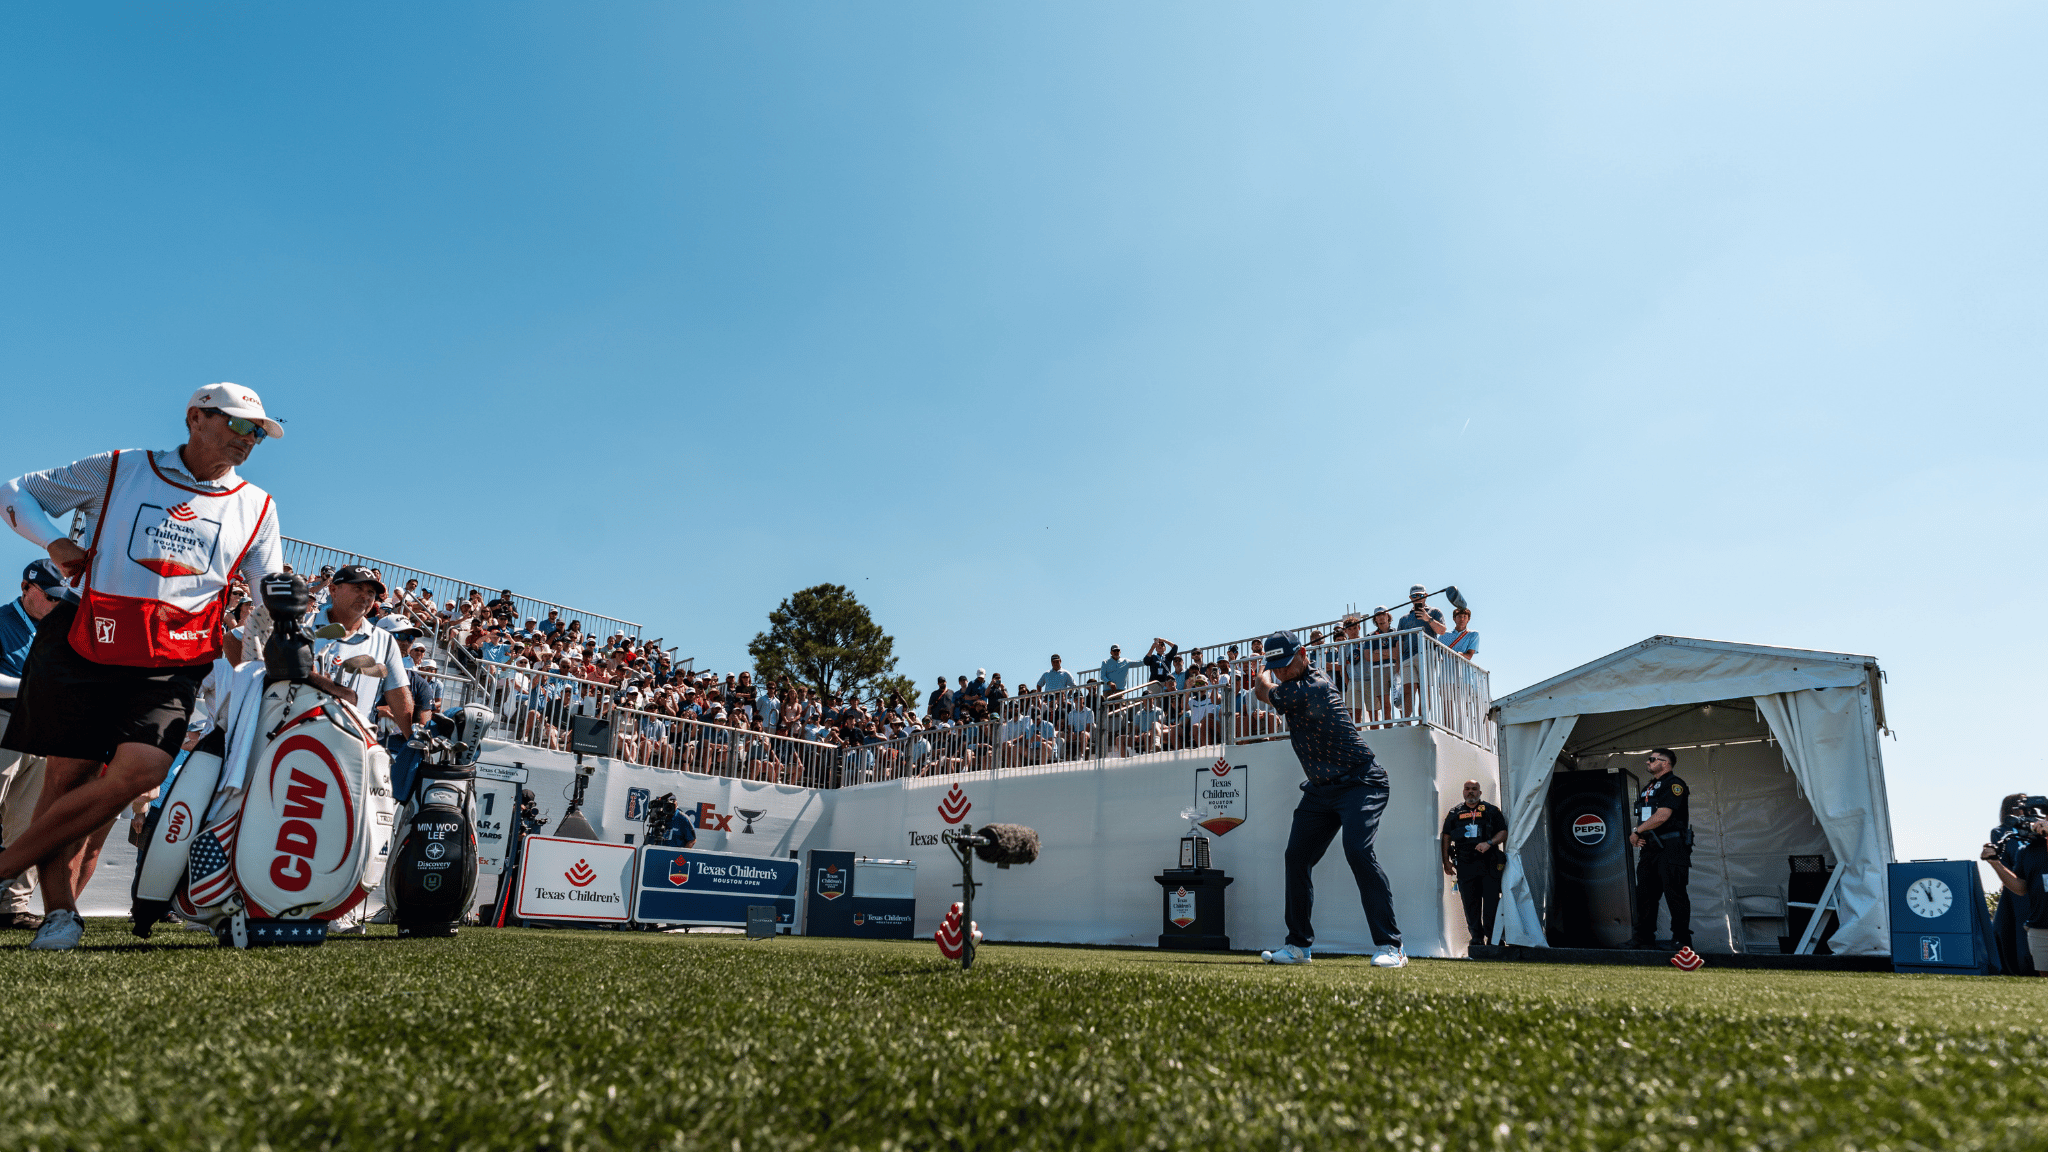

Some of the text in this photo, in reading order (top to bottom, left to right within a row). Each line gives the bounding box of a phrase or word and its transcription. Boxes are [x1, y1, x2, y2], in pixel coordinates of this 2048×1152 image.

[162, 518, 195, 535] Texas
[145, 526, 205, 548] Children's
[153, 539, 193, 551] HOUSTON
[161, 545, 183, 554] OPEN
[466, 711, 483, 760] QUANTUM
[479, 766, 493, 774] Texas
[1210, 779, 1232, 787] Texas
[1202, 789, 1240, 799] Children's
[483, 792, 495, 816] 1
[165, 810, 186, 844] CDW
[270, 767, 328, 892] CDW
[417, 823, 459, 832] MIN WOO
[476, 820, 501, 830] AR 4
[1574, 825, 1604, 833] PEPSI
[428, 831, 446, 840] LEE
[479, 831, 502, 840] YARDS
[908, 831, 938, 846] Texas
[417, 860, 451, 869] Discovery
[697, 862, 778, 880] Texas Children's
[713, 877, 743, 885] HOUSTON
[535, 887, 620, 903] Texas Children's
[867, 913, 912, 922] Texas Children's
